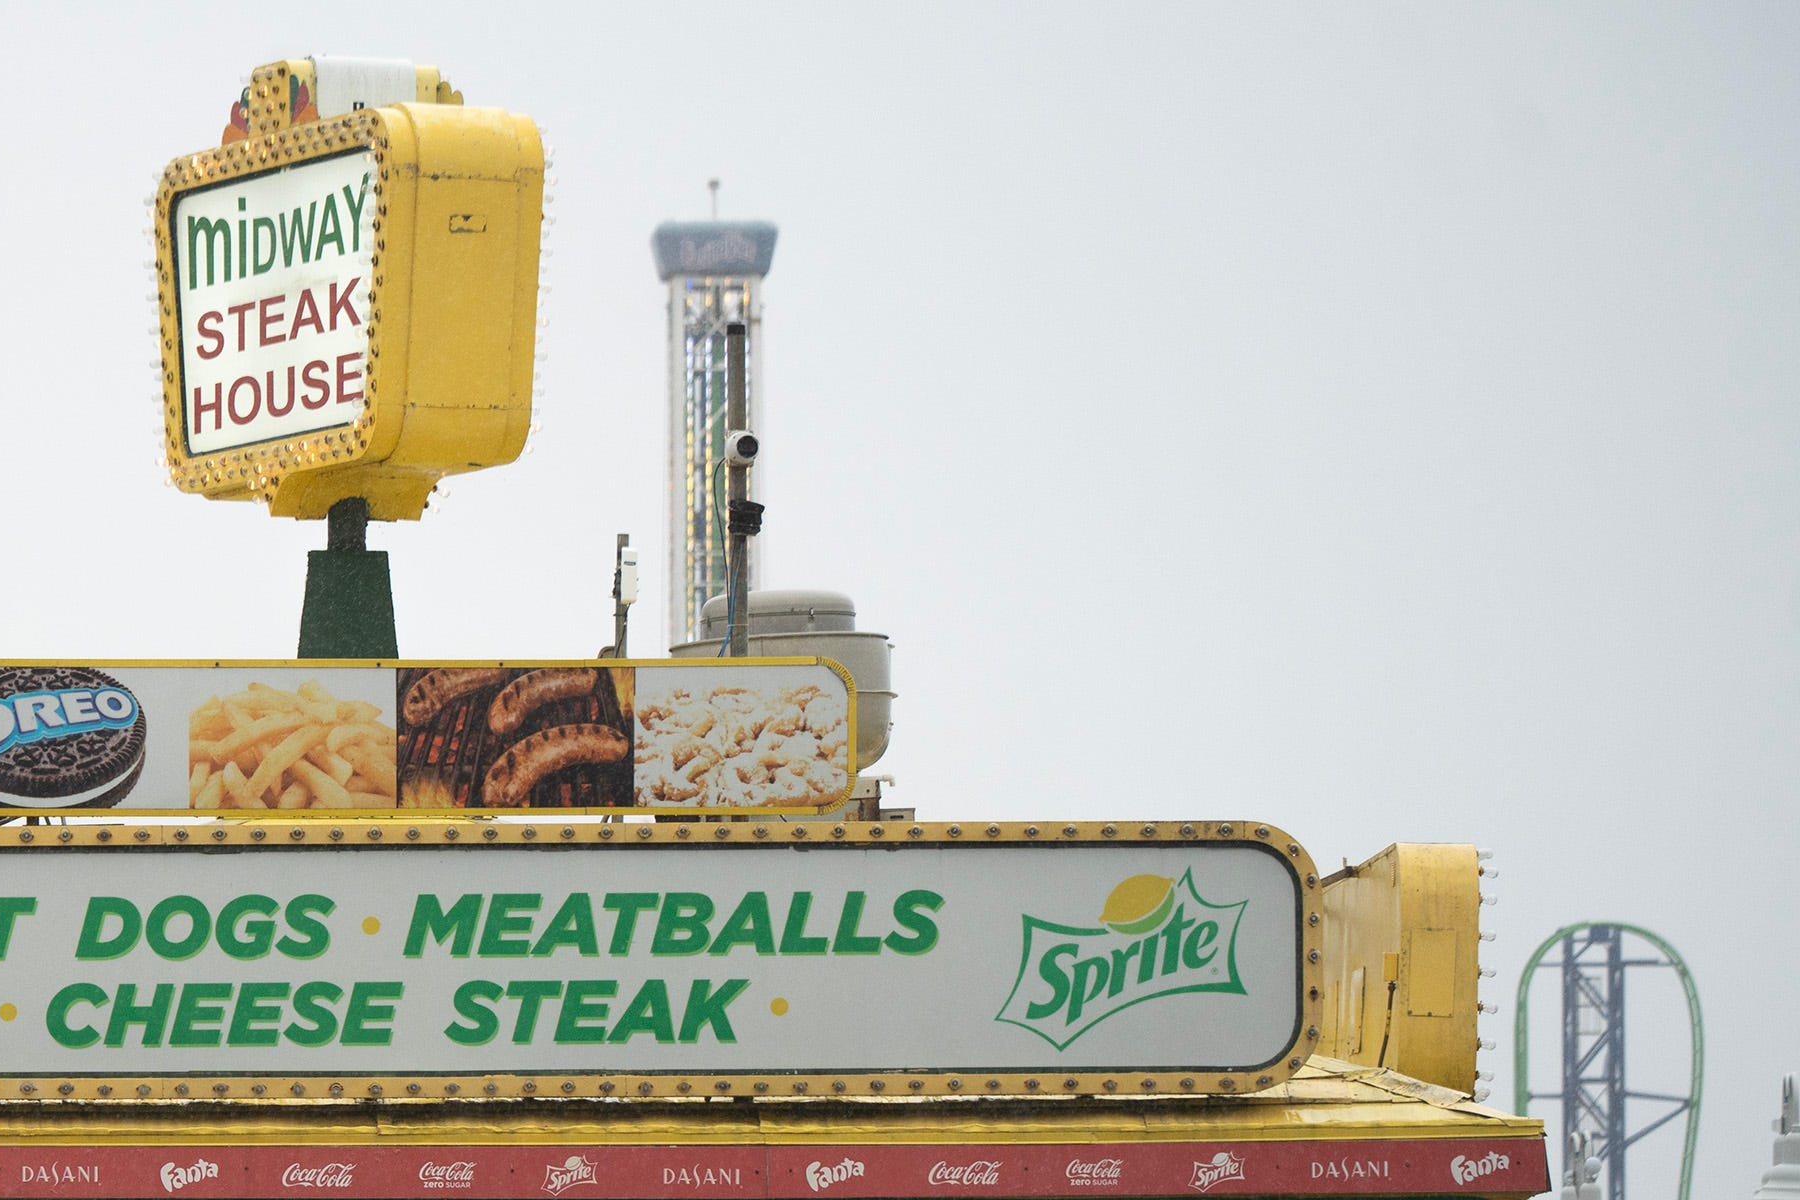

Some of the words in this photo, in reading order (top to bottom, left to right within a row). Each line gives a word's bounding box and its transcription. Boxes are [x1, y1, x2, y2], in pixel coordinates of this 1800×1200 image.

[196, 276, 361, 361] STEAK
[192, 352, 364, 434] HOUSE
[75, 894, 337, 961] DOGS
[402, 890, 946, 957] MEATBALLS
[1026, 911, 1219, 1026] Sprite
[46, 981, 404, 1049] CHEESE
[444, 978, 750, 1046] STEAK
[21, 1164, 100, 1183] DASANI
[160, 1158, 219, 1192] Fanta
[282, 1162, 357, 1188] Coca-Cola
[419, 1161, 478, 1182] Coca-Cola
[546, 1161, 594, 1190] Sprite
[662, 1167, 741, 1185] DASANI
[806, 1157, 864, 1191] Fanta
[927, 1160, 1003, 1186] Coca-Cola
[1066, 1158, 1124, 1179] Coca-Cola
[1092, 1177, 1118, 1186] SUGAR
[1194, 1157, 1243, 1187] Sprite
[1311, 1160, 1389, 1180] DASANI
[1450, 1152, 1511, 1185] Fanta
[445, 1180, 471, 1188] SUGAR
